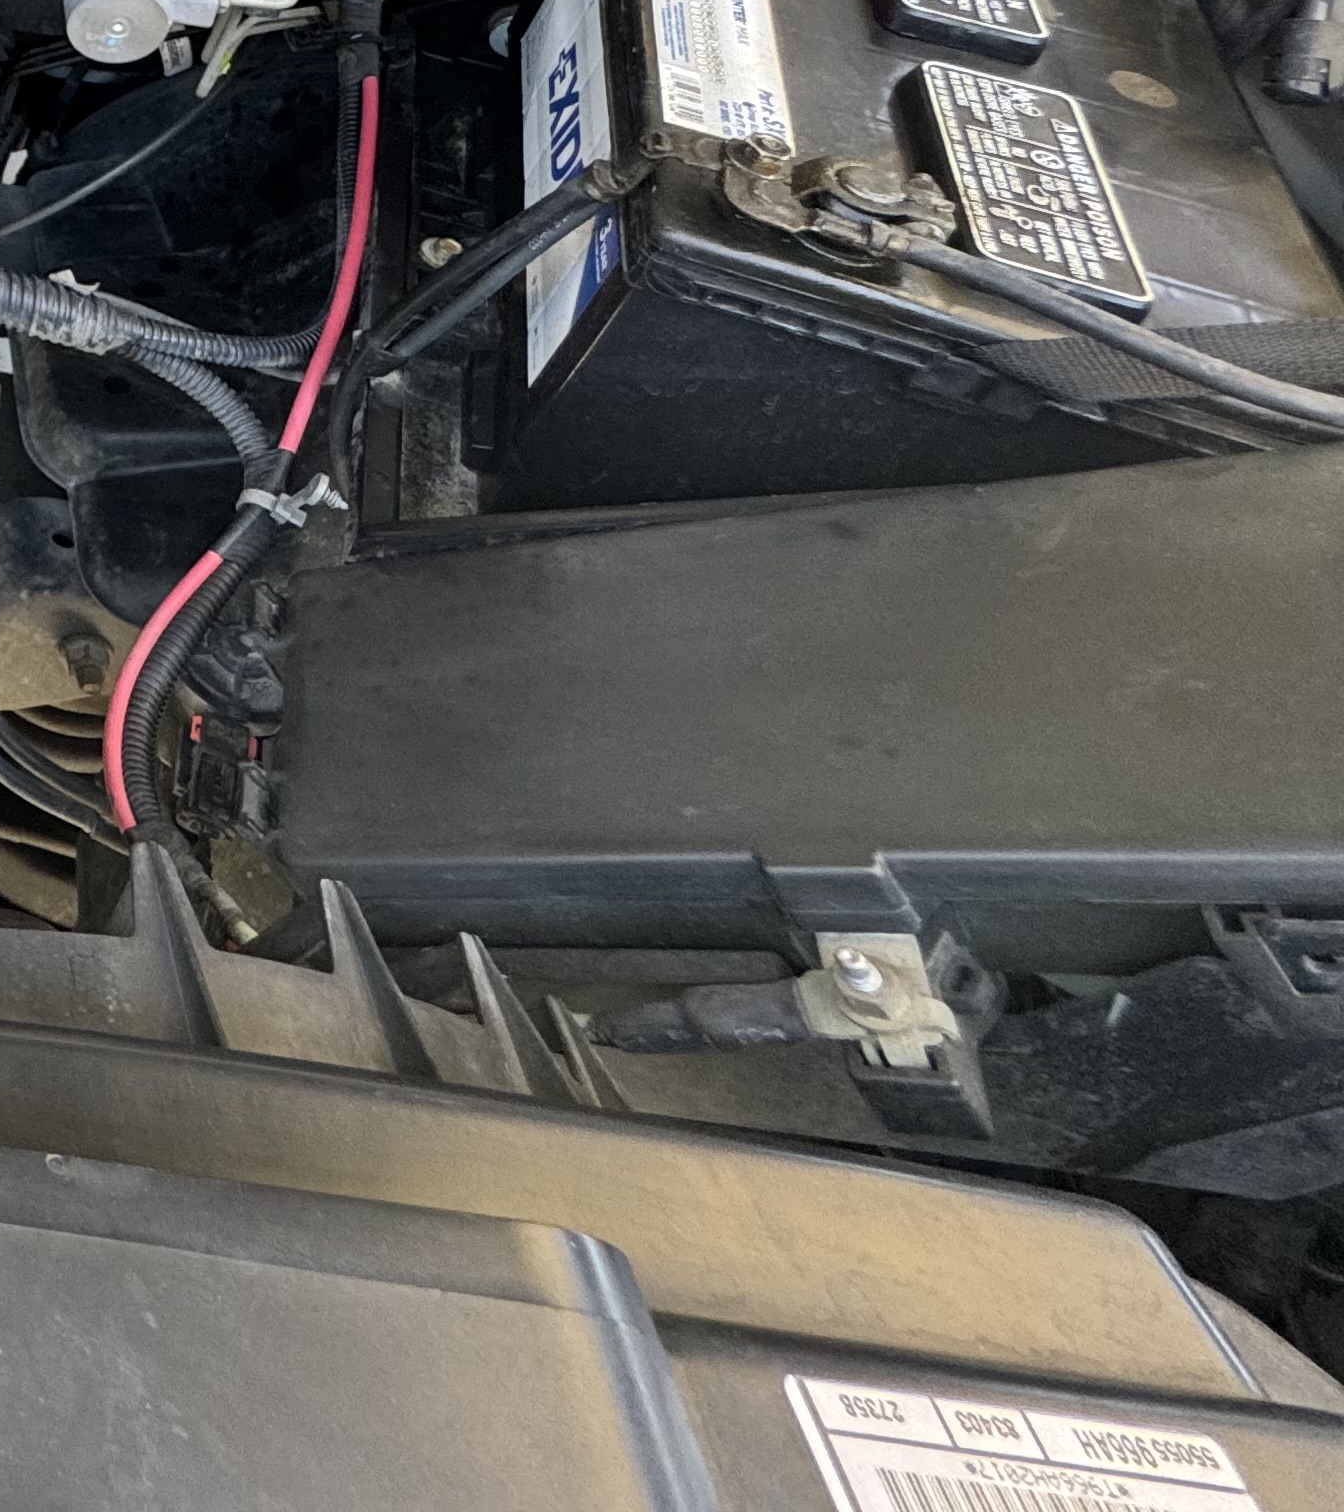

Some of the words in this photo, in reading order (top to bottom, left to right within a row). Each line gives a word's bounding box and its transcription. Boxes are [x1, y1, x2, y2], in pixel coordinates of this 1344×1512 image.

[548, 42, 584, 182] EXID
[599, 217, 613, 239] 3
[1055, 133, 1128, 262] DANGER/POISON
[954, 1409, 1021, 1440] 83403
